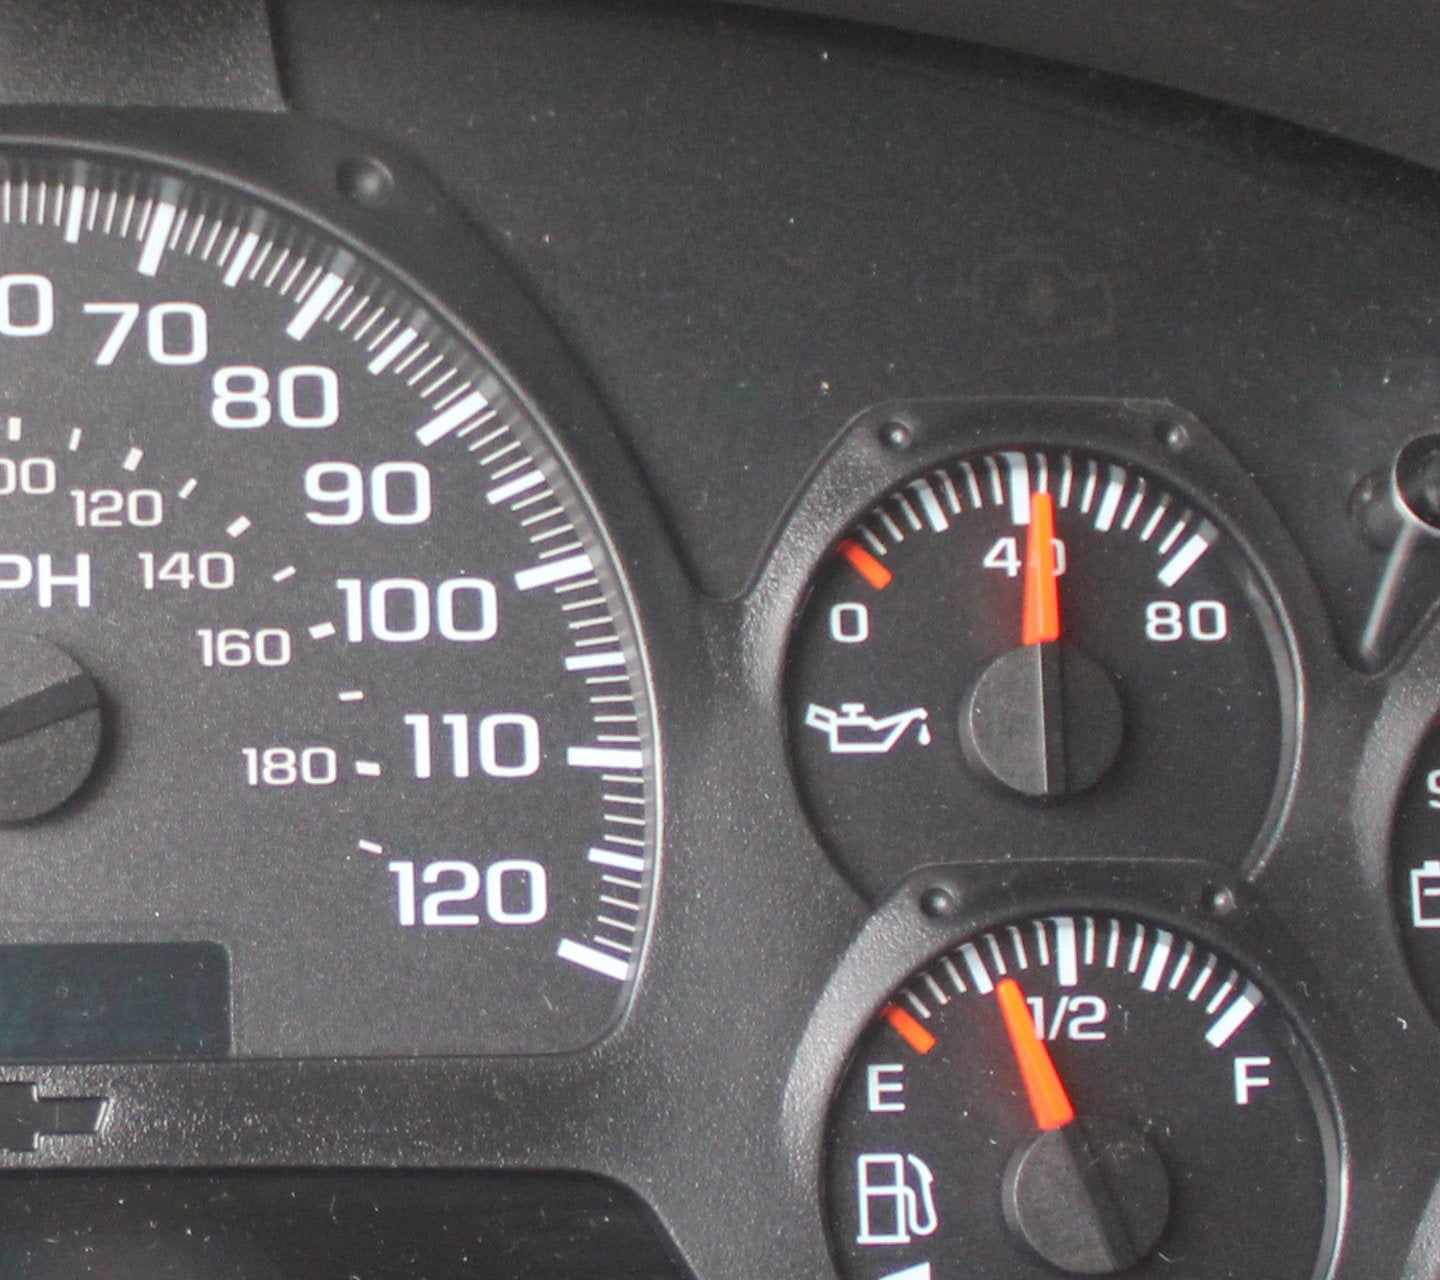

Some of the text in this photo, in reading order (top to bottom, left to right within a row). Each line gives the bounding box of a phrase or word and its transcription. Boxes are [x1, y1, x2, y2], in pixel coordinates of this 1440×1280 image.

[82, 301, 209, 367] 70
[210, 364, 340, 430] 80
[69, 488, 164, 528] 120
[303, 461, 432, 527] 90
[137, 551, 236, 591] 140
[335, 576, 499, 644] 100
[829, 601, 870, 645] 0
[1144, 599, 1228, 643] 80
[195, 627, 292, 668] 160
[240, 745, 338, 787] 180
[402, 712, 541, 780] 110
[387, 858, 548, 927] 120
[1025, 994, 1108, 1041] 1/2
[866, 1062, 907, 1113] E
[1232, 1055, 1272, 1106] F
